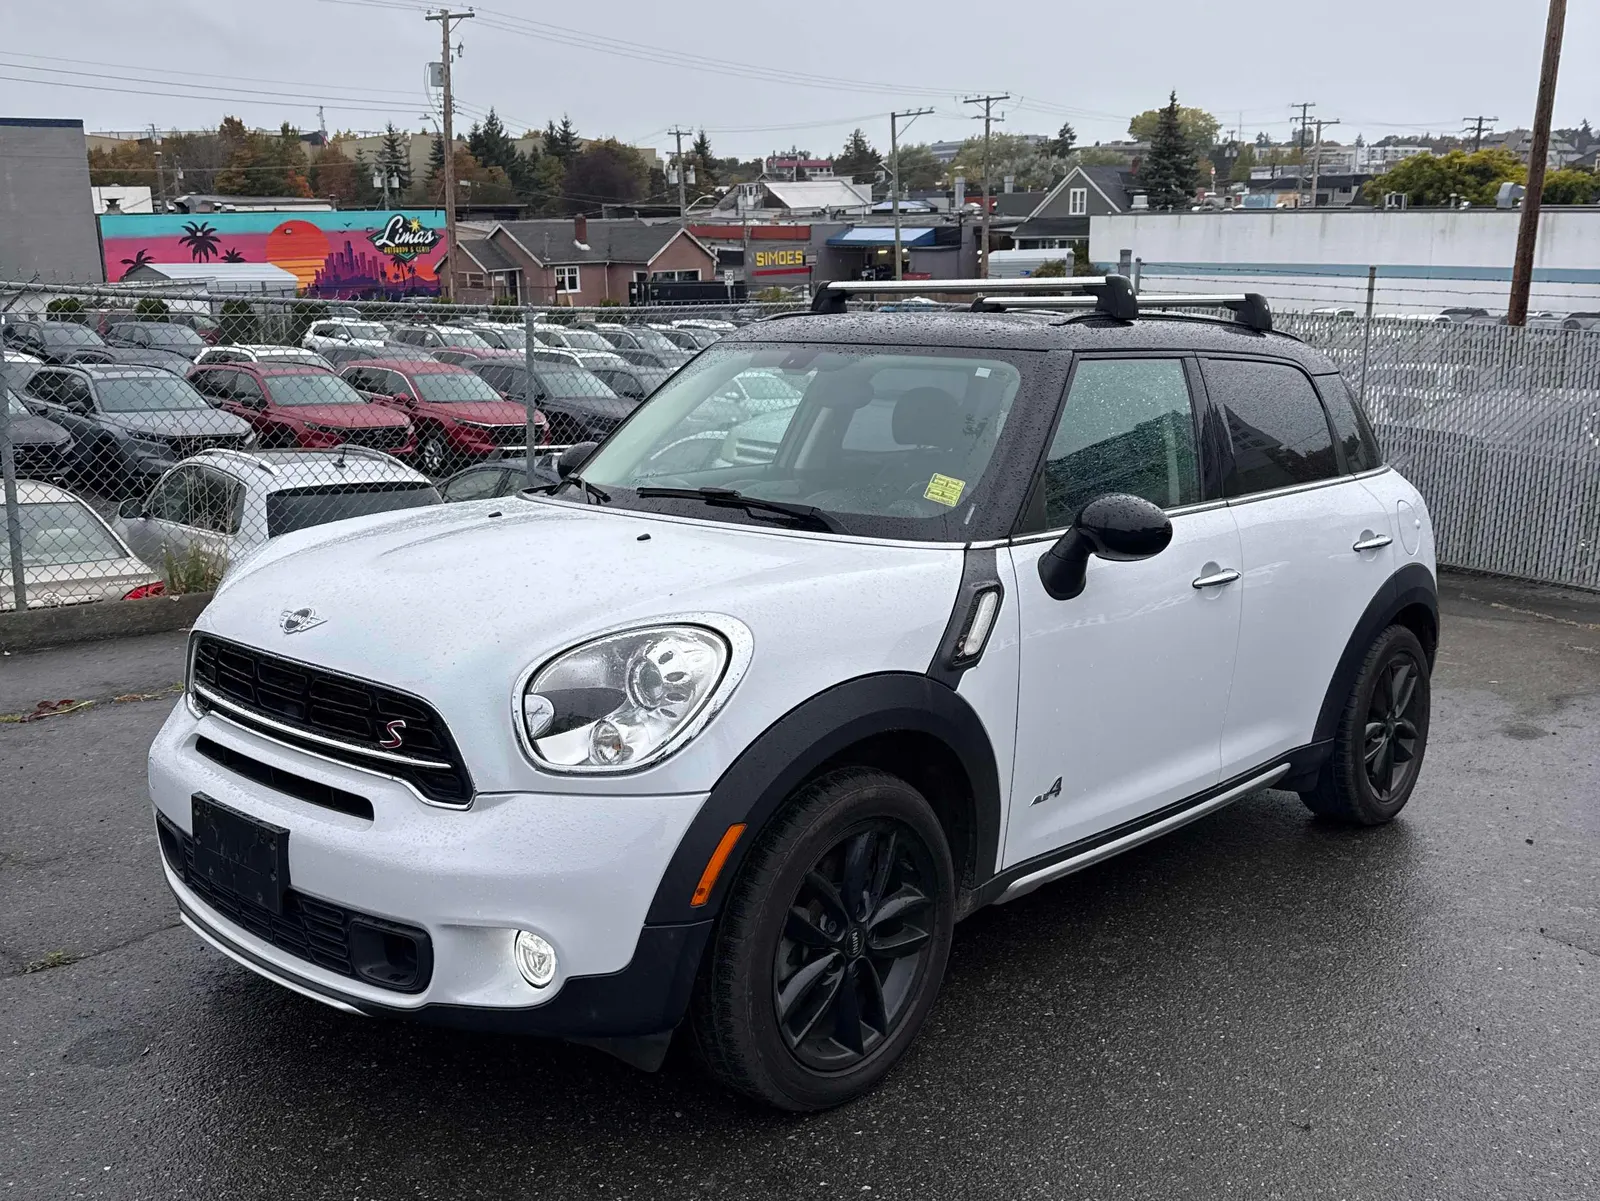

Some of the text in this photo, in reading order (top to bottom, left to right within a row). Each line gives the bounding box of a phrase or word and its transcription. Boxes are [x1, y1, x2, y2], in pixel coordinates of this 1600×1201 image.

[375, 215, 435, 247] Limas
[755, 250, 804, 268] SIMOES
[380, 719, 407, 749] S
